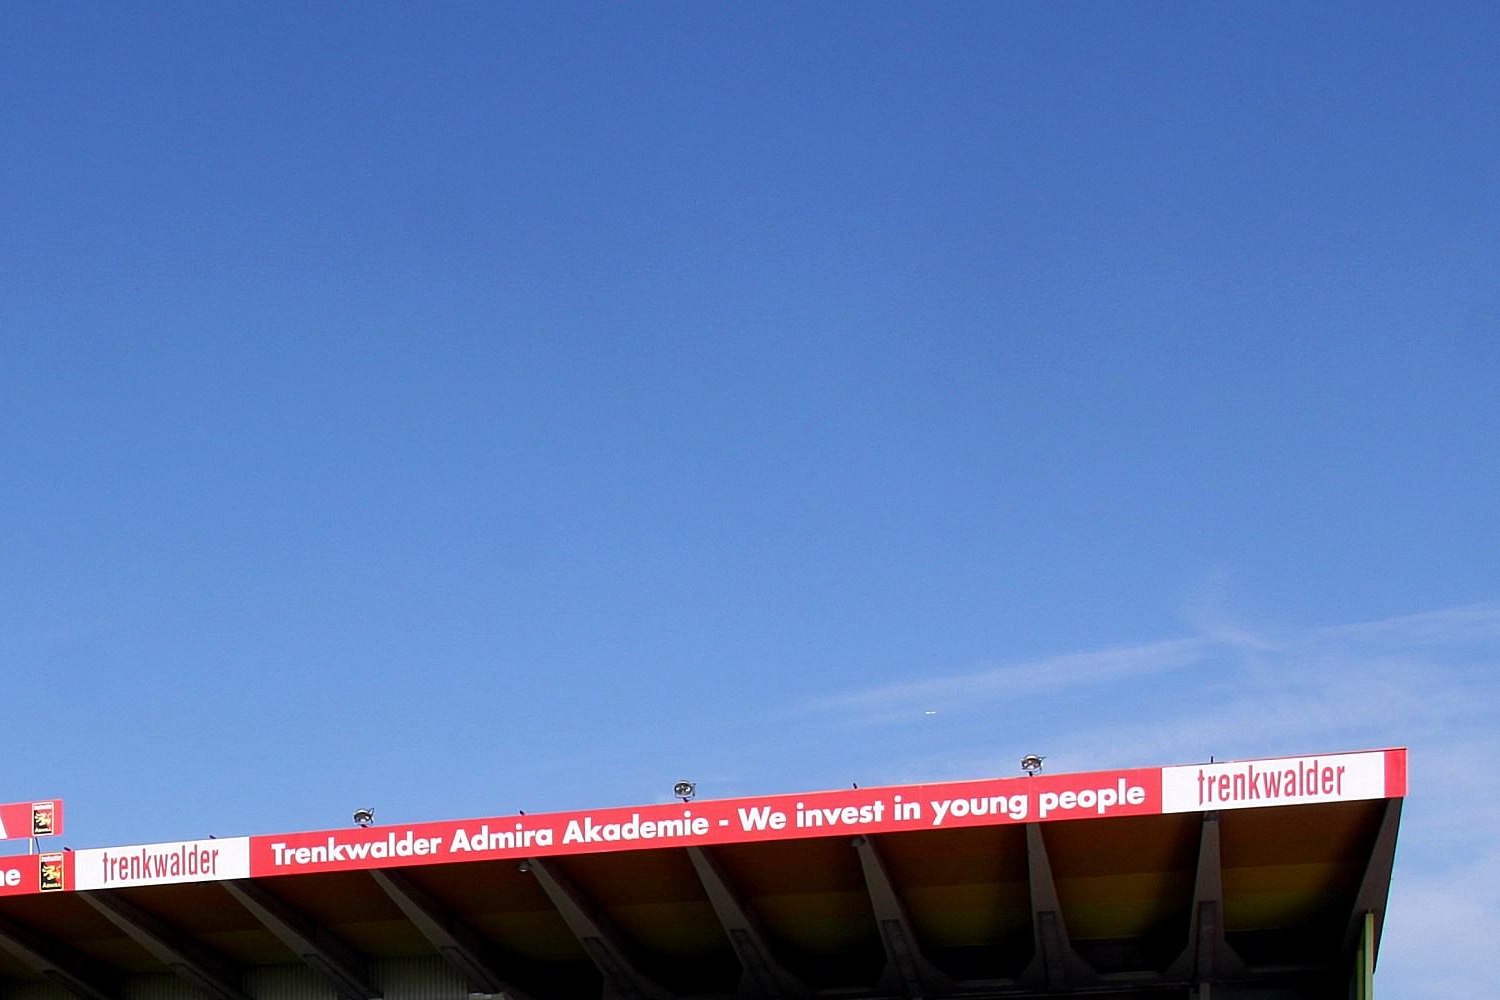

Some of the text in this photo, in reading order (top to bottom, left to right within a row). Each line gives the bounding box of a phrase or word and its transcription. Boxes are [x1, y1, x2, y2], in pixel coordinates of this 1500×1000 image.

[1198, 760, 1347, 806] trenkwalder
[271, 778, 1146, 866] Trenkwalder Admira Akademie - We invest in young people
[103, 846, 219, 884] trenkwalder
